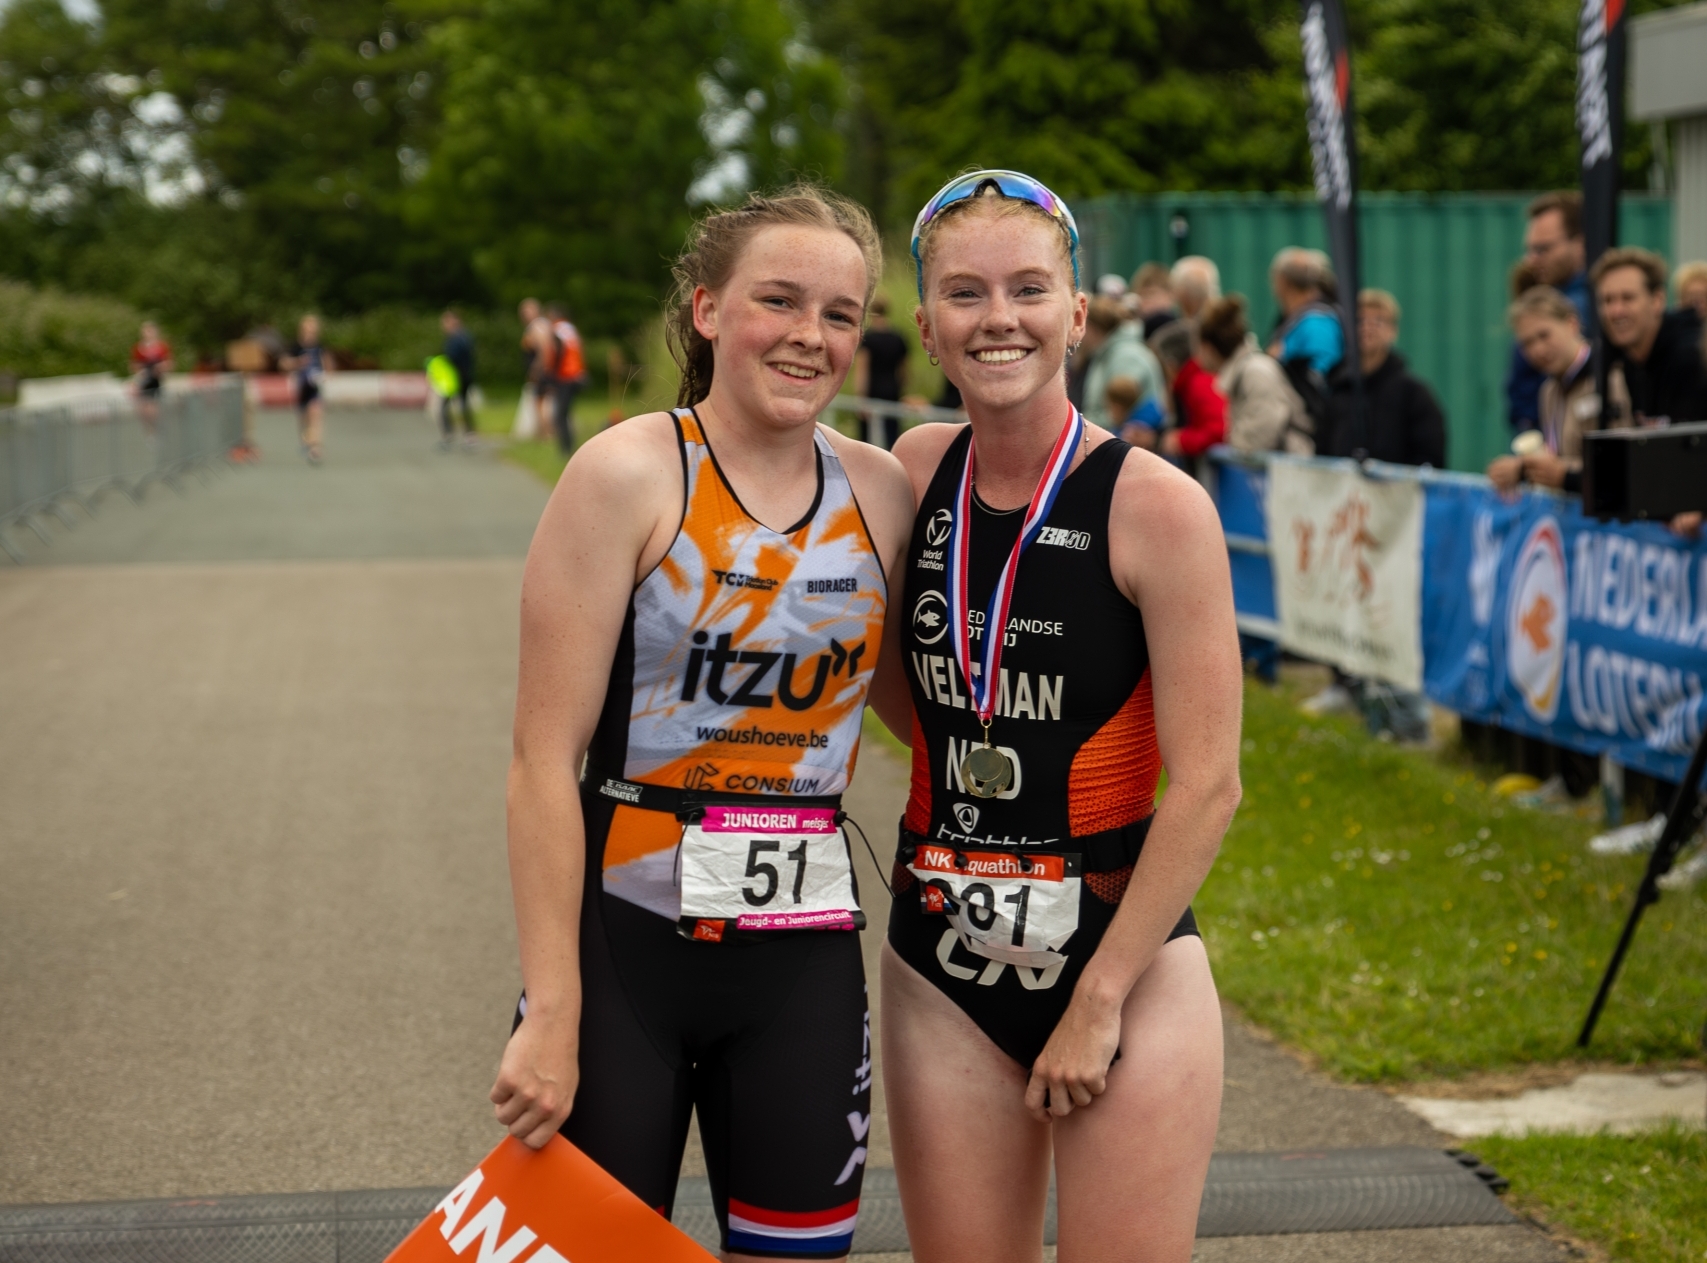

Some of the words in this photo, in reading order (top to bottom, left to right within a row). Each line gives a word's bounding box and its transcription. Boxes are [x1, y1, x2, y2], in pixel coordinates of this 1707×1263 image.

[922, 549, 943, 560] World
[917, 559, 944, 571] Triathlon
[807, 578, 857, 593] BIORACER
[680, 630, 832, 711] itzu
[697, 726, 829, 748] woushoeve.be
[946, 735, 1022, 800] ND
[725, 774, 820, 793] CONSIUM
[721, 813, 797, 829] JUNIOREN
[924, 850, 952, 869] NK
[741, 839, 808, 907] 51
[774, 918, 786, 926] en
[788, 911, 851, 925] Juniorencircuit
[434, 1167, 573, 1263] AN
